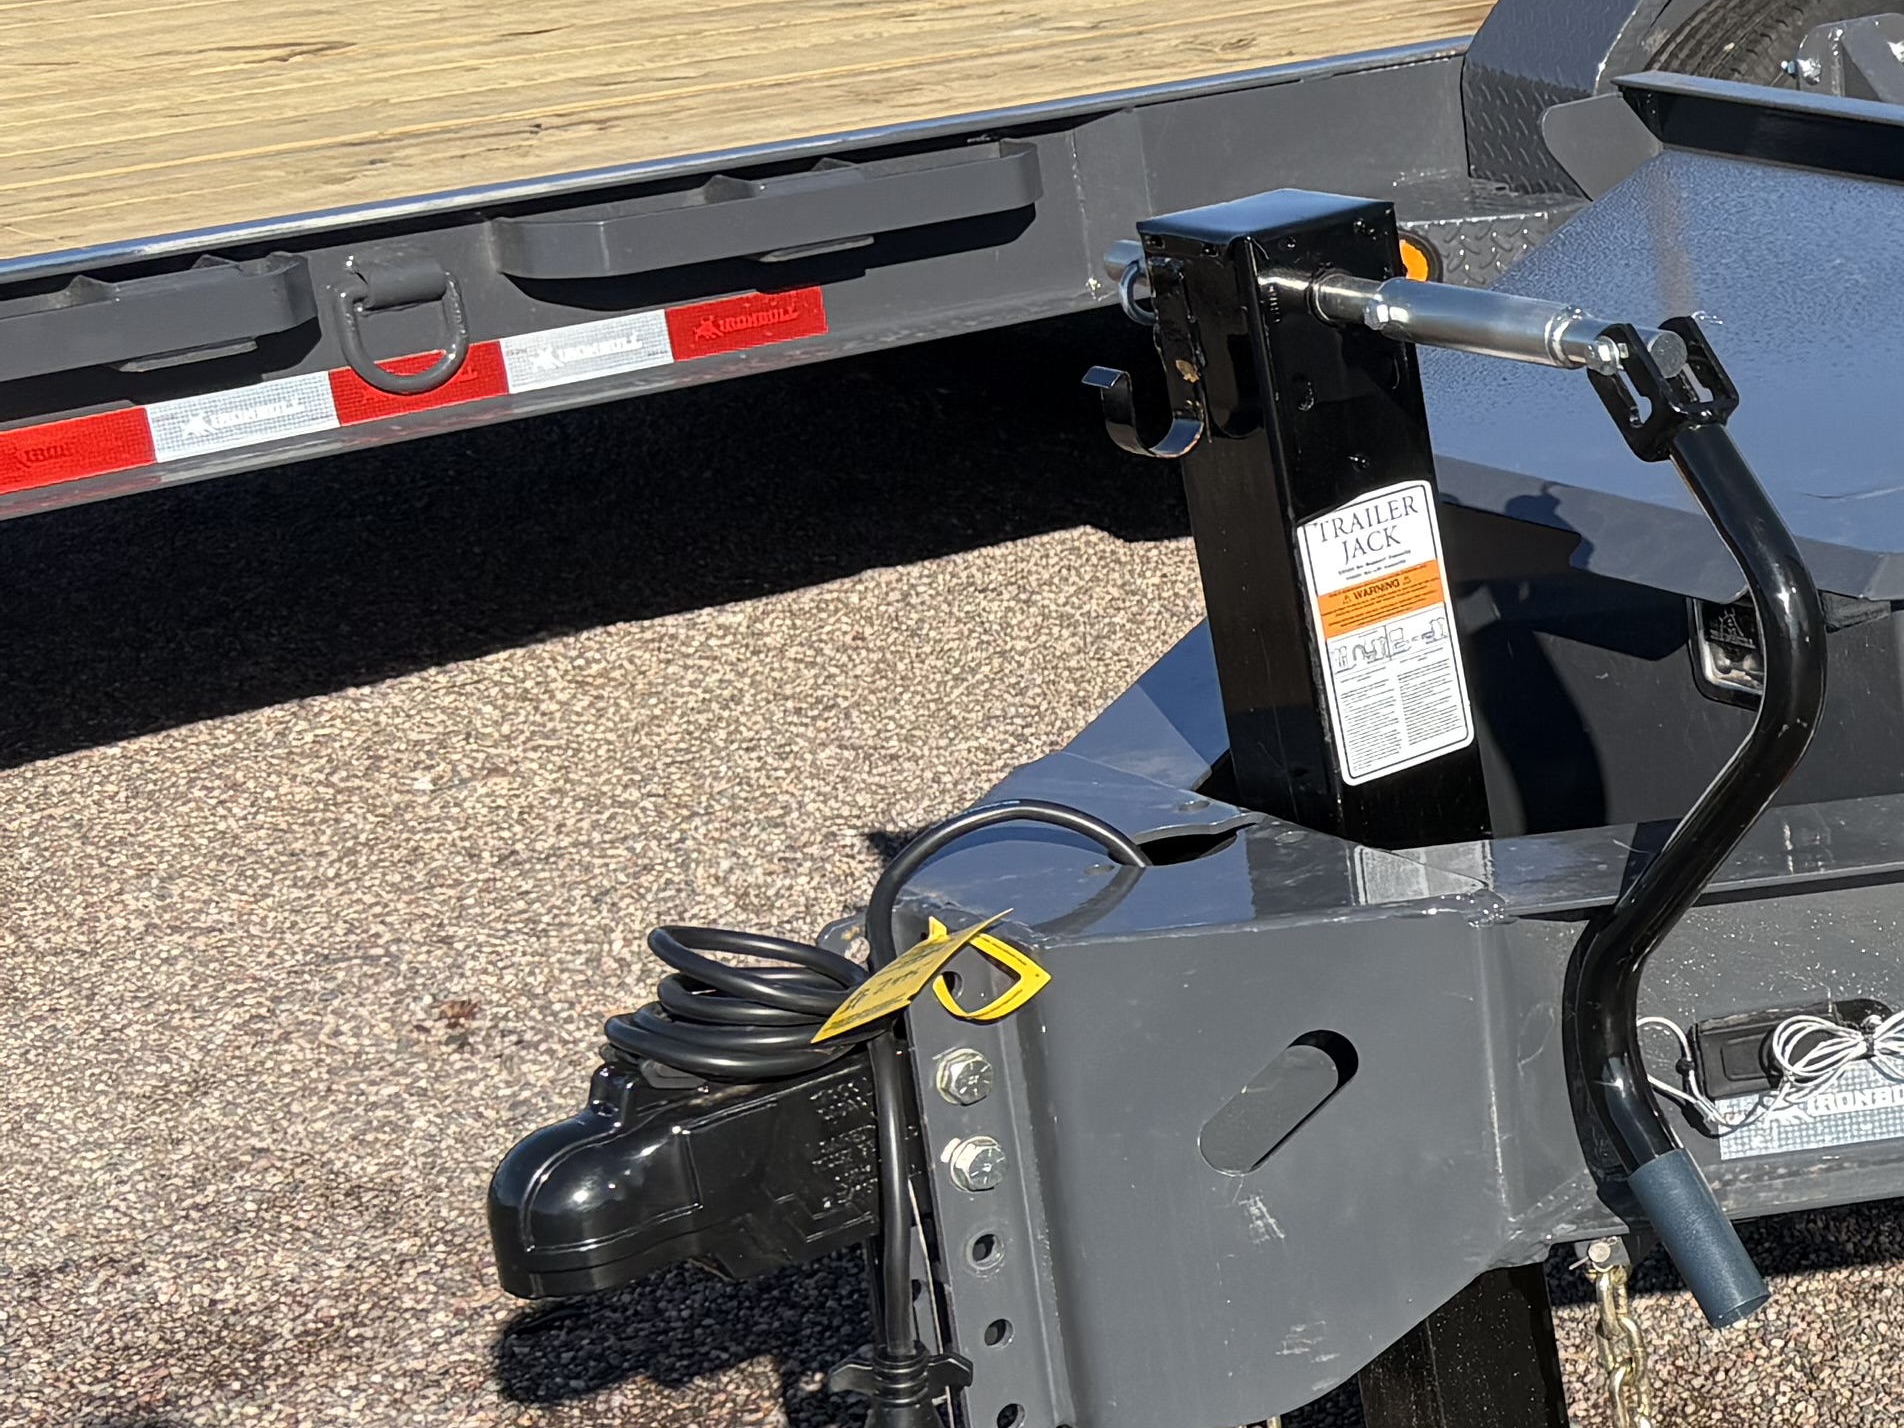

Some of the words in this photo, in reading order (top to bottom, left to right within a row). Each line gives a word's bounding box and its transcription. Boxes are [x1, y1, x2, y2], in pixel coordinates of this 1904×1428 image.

[1310, 495, 1418, 542] TRAILER
[1342, 525, 1401, 565] JACK
[1353, 579, 1400, 599] WARNING
